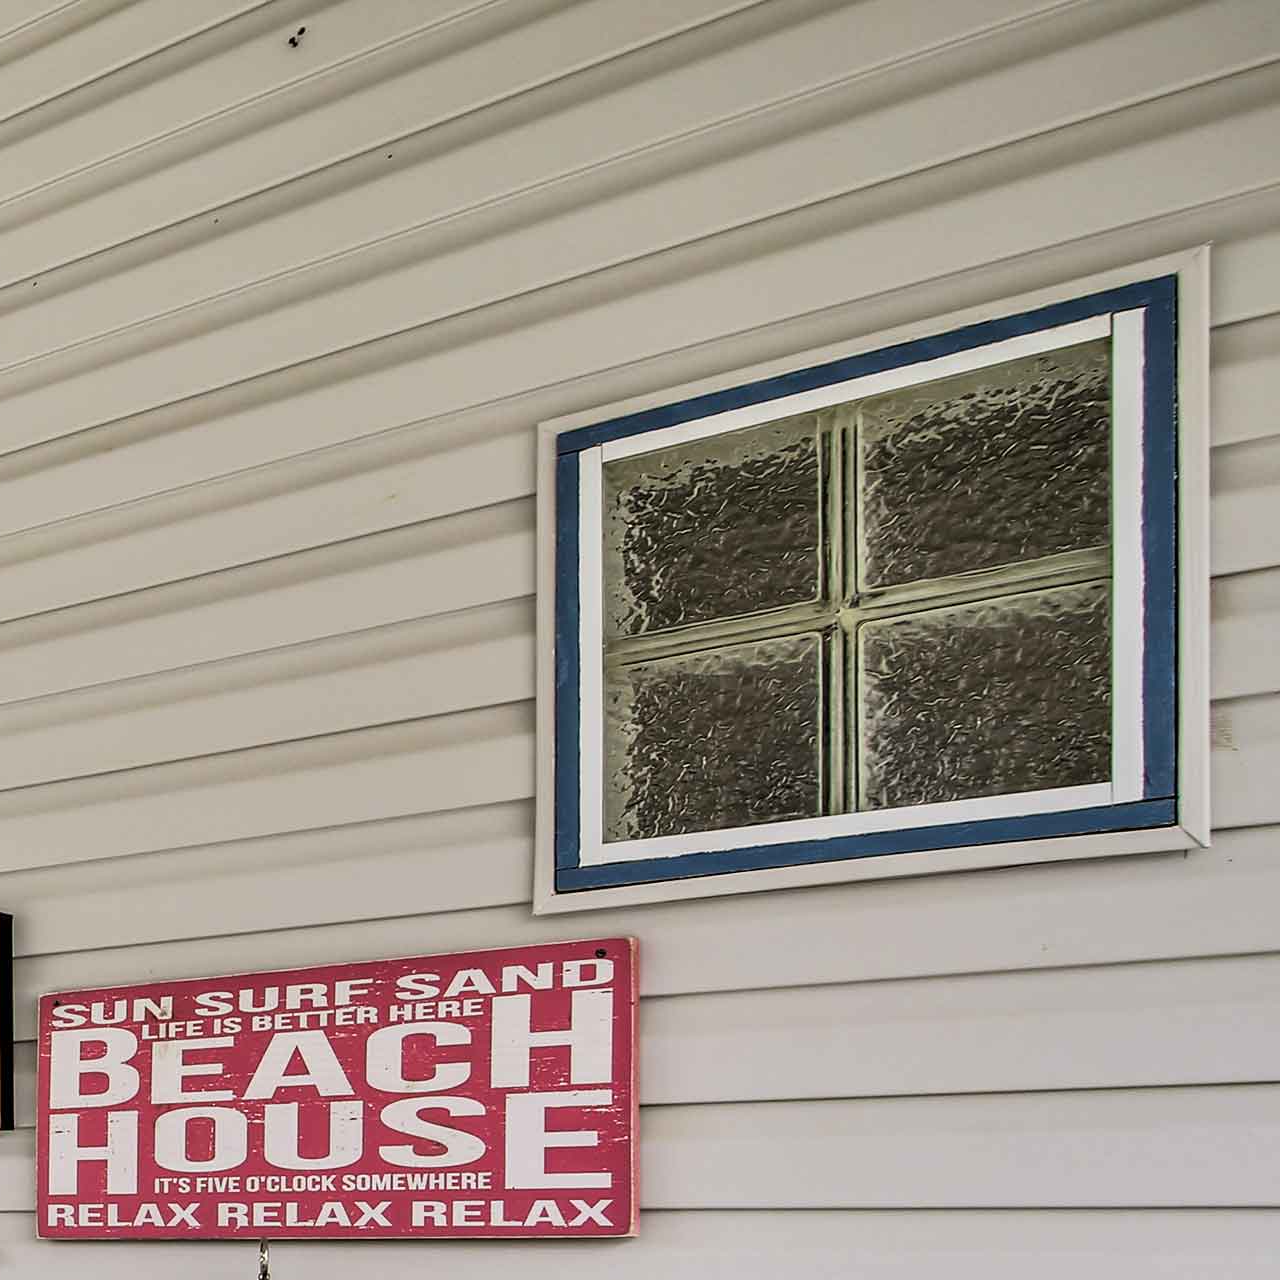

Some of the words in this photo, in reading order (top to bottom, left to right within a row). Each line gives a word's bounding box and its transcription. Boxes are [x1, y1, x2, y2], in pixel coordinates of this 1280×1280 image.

[51, 996, 174, 1029] SUN
[194, 978, 374, 1016] SURF
[395, 959, 615, 1001] SAND
[141, 1018, 205, 1040] LIFE
[213, 1016, 242, 1035] IS
[252, 1006, 378, 1032] BETTER
[389, 997, 485, 1023] HERE
[49, 987, 614, 1109] BEACH
[48, 1089, 613, 1195] HOUSE
[154, 1176, 190, 1194] IT'S
[196, 1176, 240, 1193] FIVE
[246, 1174, 337, 1193] O'CLOCK
[342, 1172, 492, 1191] SOMEWHERE
[47, 1201, 201, 1228] RELAX
[217, 1200, 393, 1227] RELAX
[412, 1199, 615, 1227] RELAX
